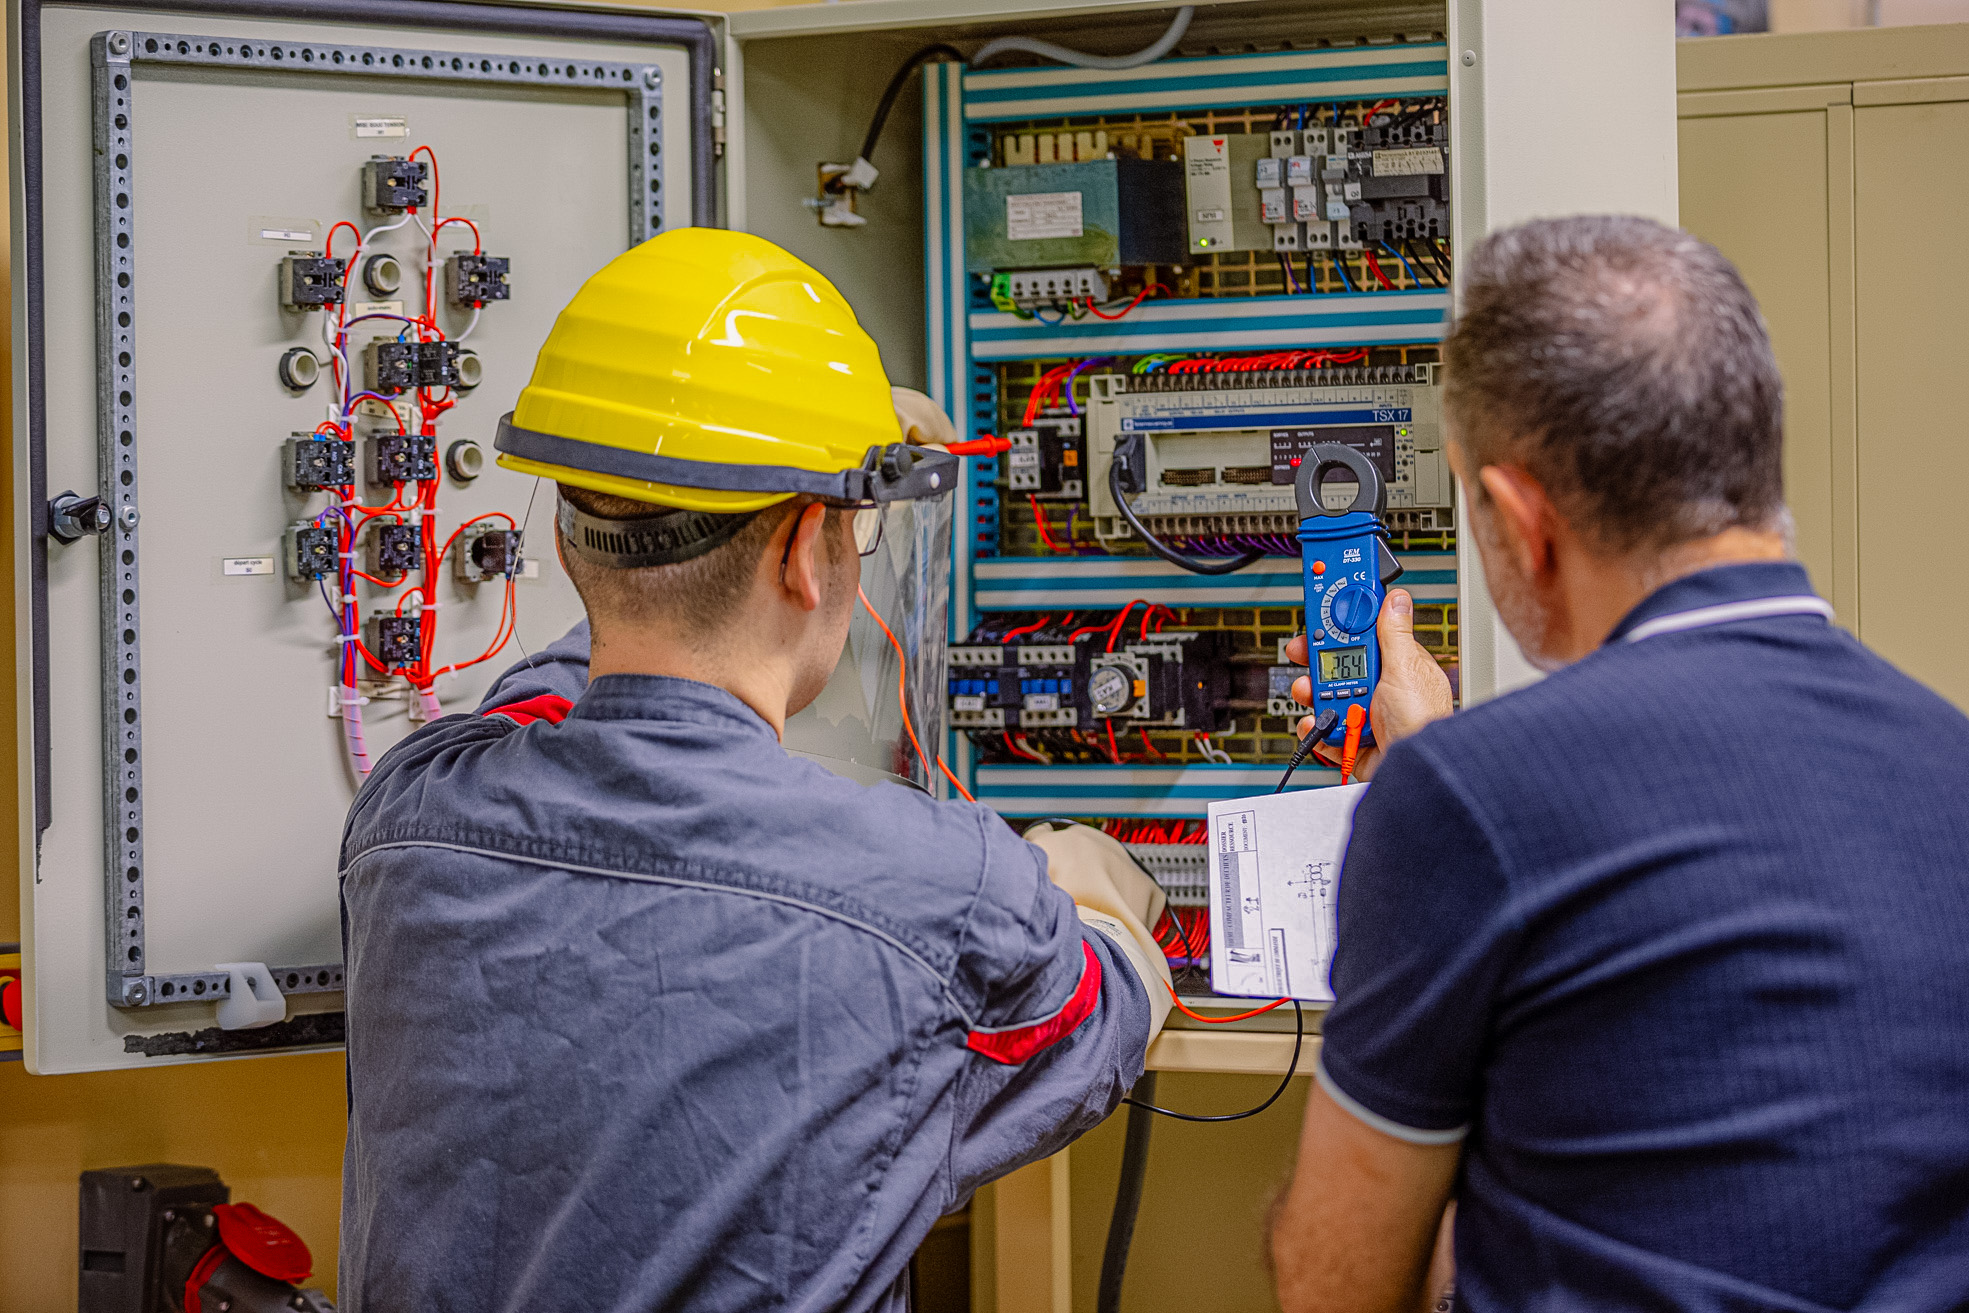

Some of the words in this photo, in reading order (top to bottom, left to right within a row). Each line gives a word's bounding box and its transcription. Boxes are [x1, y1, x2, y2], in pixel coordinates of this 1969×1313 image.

[1372, 410, 1395, 422] TSX
[1398, 409, 1409, 421] 17
[1343, 548, 1360, 557] CEM
[1331, 655, 1362, 679] 264
